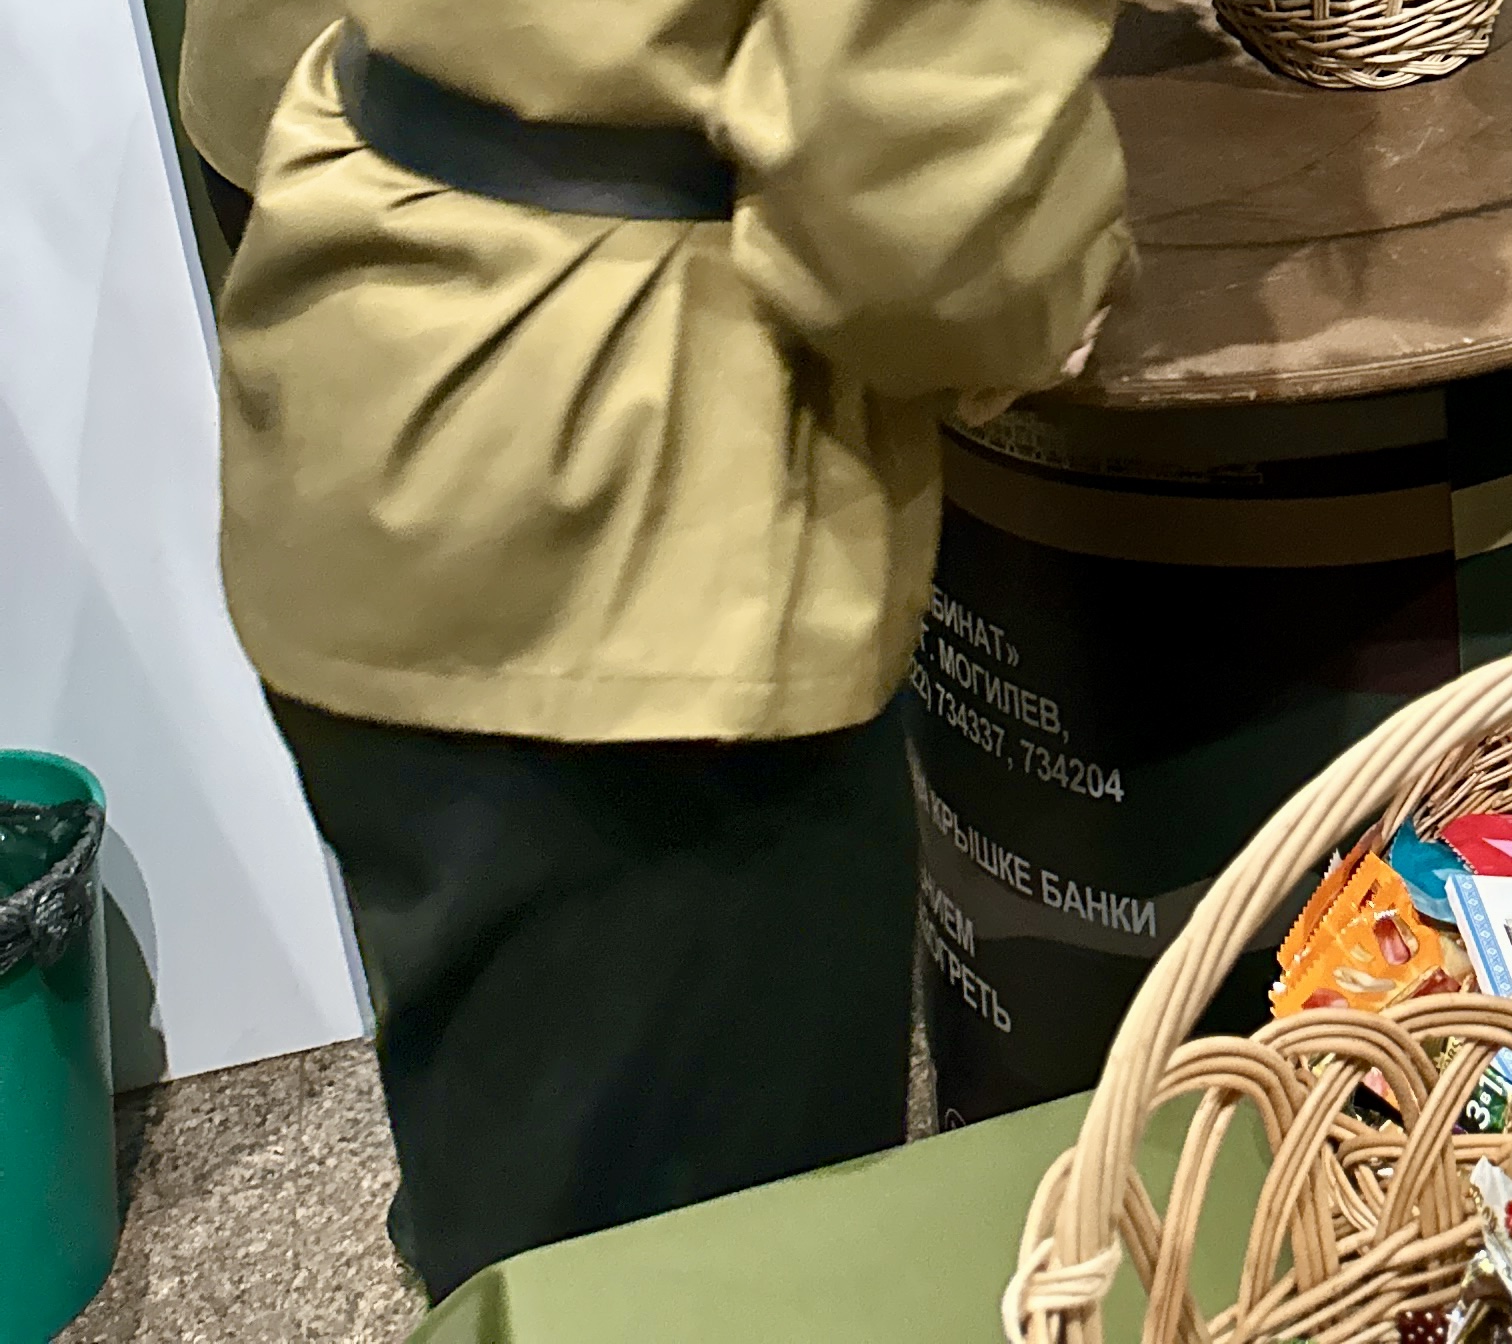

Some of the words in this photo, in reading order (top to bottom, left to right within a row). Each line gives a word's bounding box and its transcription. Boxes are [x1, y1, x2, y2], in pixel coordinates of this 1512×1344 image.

[931, 583, 1020, 667] БИНАТ»
[938, 637, 1069, 745] МОГИЛЕВ,
[1020, 739, 1125, 803] 734204
[929, 790, 1034, 896] КРЫШКЕ
[1040, 869, 1157, 938] БАНКИ
